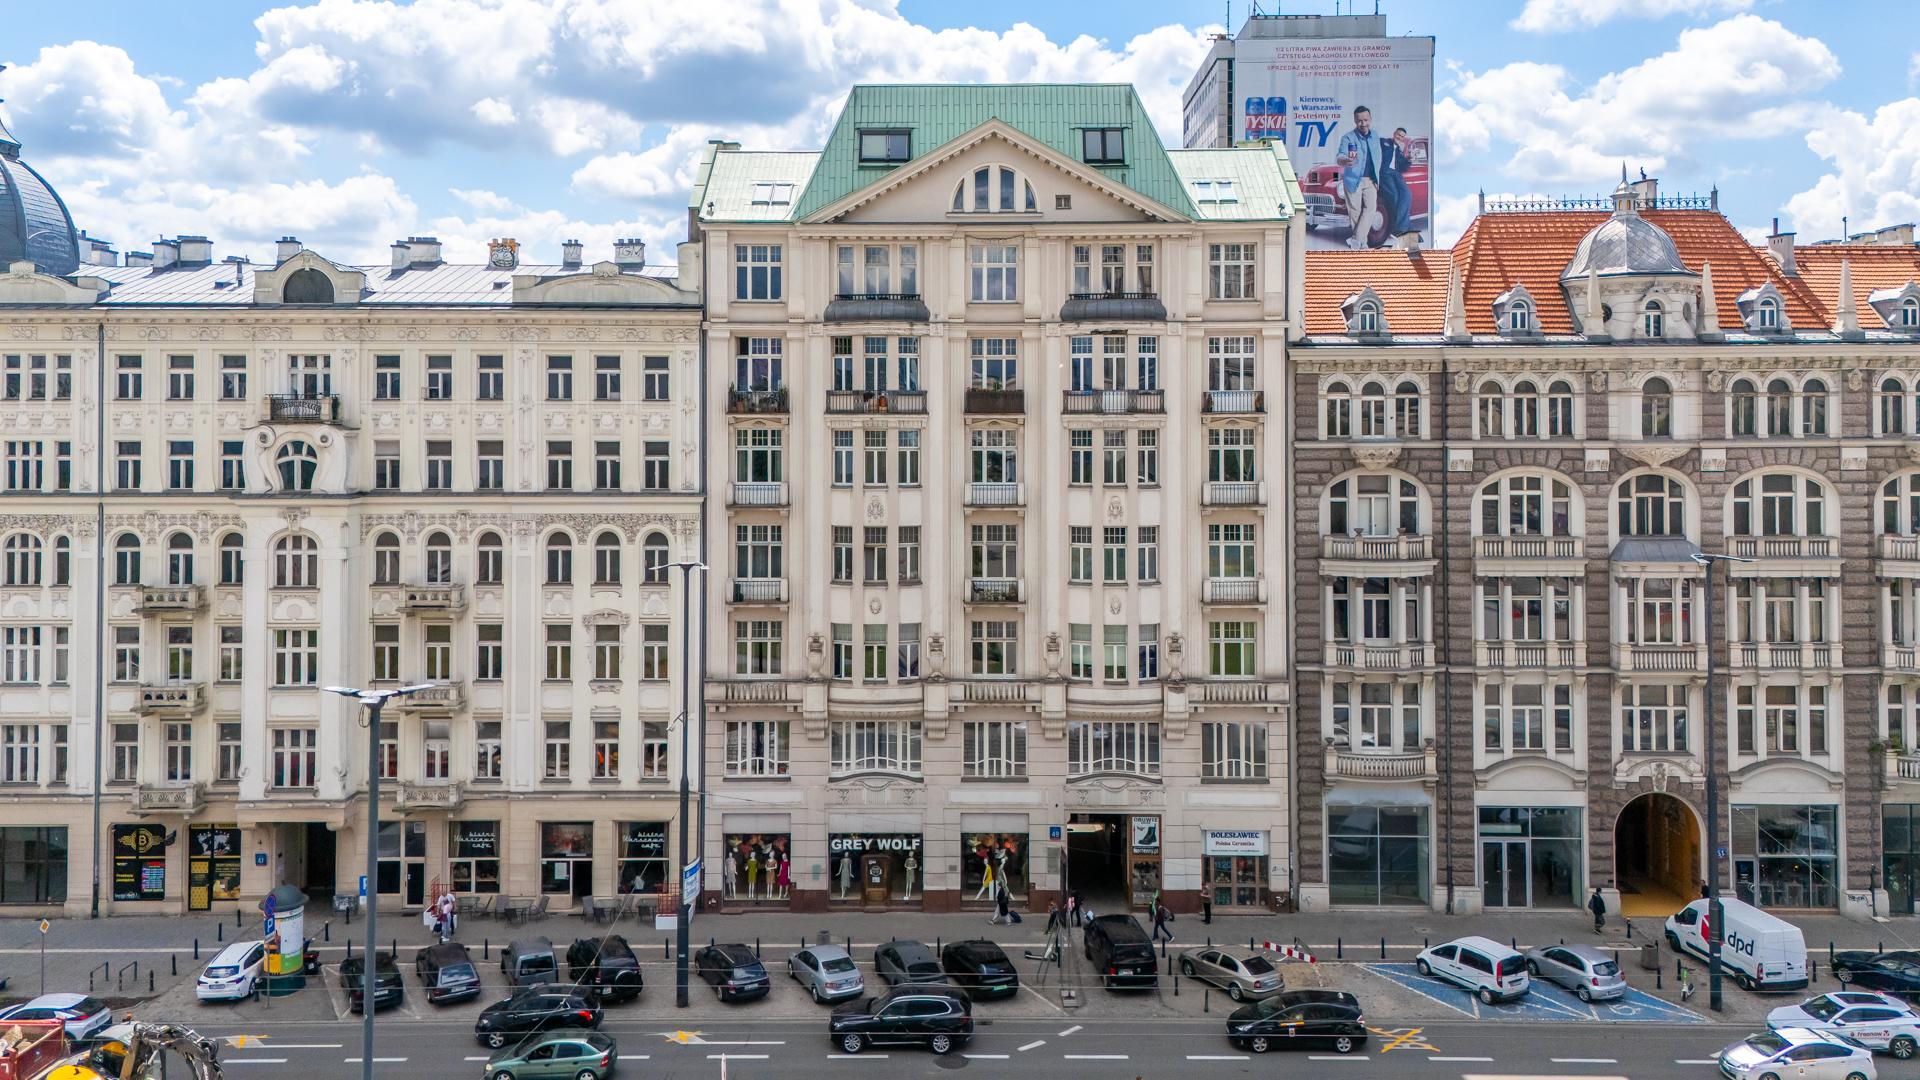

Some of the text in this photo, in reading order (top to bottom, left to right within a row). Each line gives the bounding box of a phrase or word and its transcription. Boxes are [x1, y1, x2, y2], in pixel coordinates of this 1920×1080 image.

[1296, 122, 1338, 147] TY
[832, 839, 920, 850] GREY WOLF
[267, 920, 273, 932] P
[1728, 932, 1754, 956] dpd
